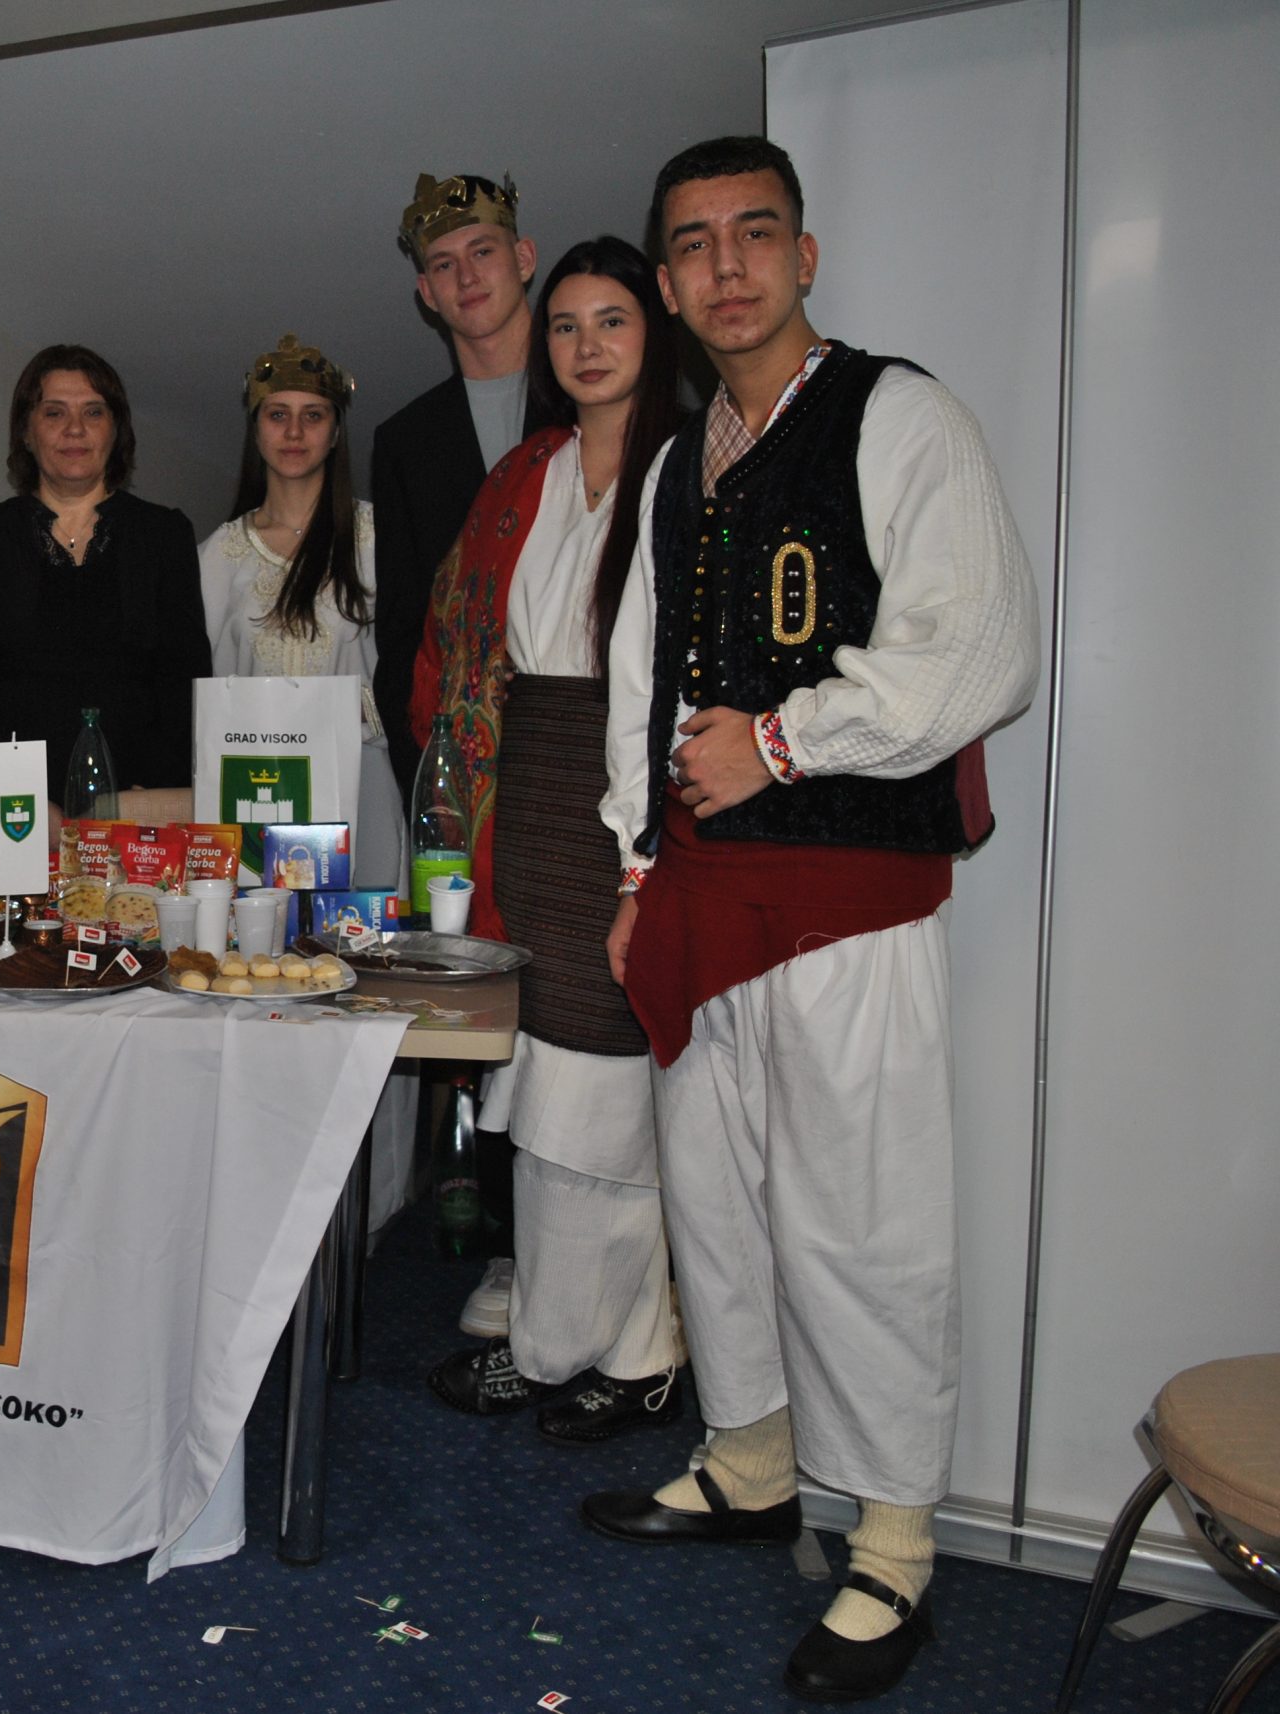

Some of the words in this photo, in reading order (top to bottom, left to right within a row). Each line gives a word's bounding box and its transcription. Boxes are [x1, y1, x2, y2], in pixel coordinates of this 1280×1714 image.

[224, 732, 257, 744] GRAD
[260, 733, 308, 744] VISOKO
[77, 841, 109, 853] Begov
[127, 842, 166, 857] Begova
[371, 896, 381, 930] KAMILICA
